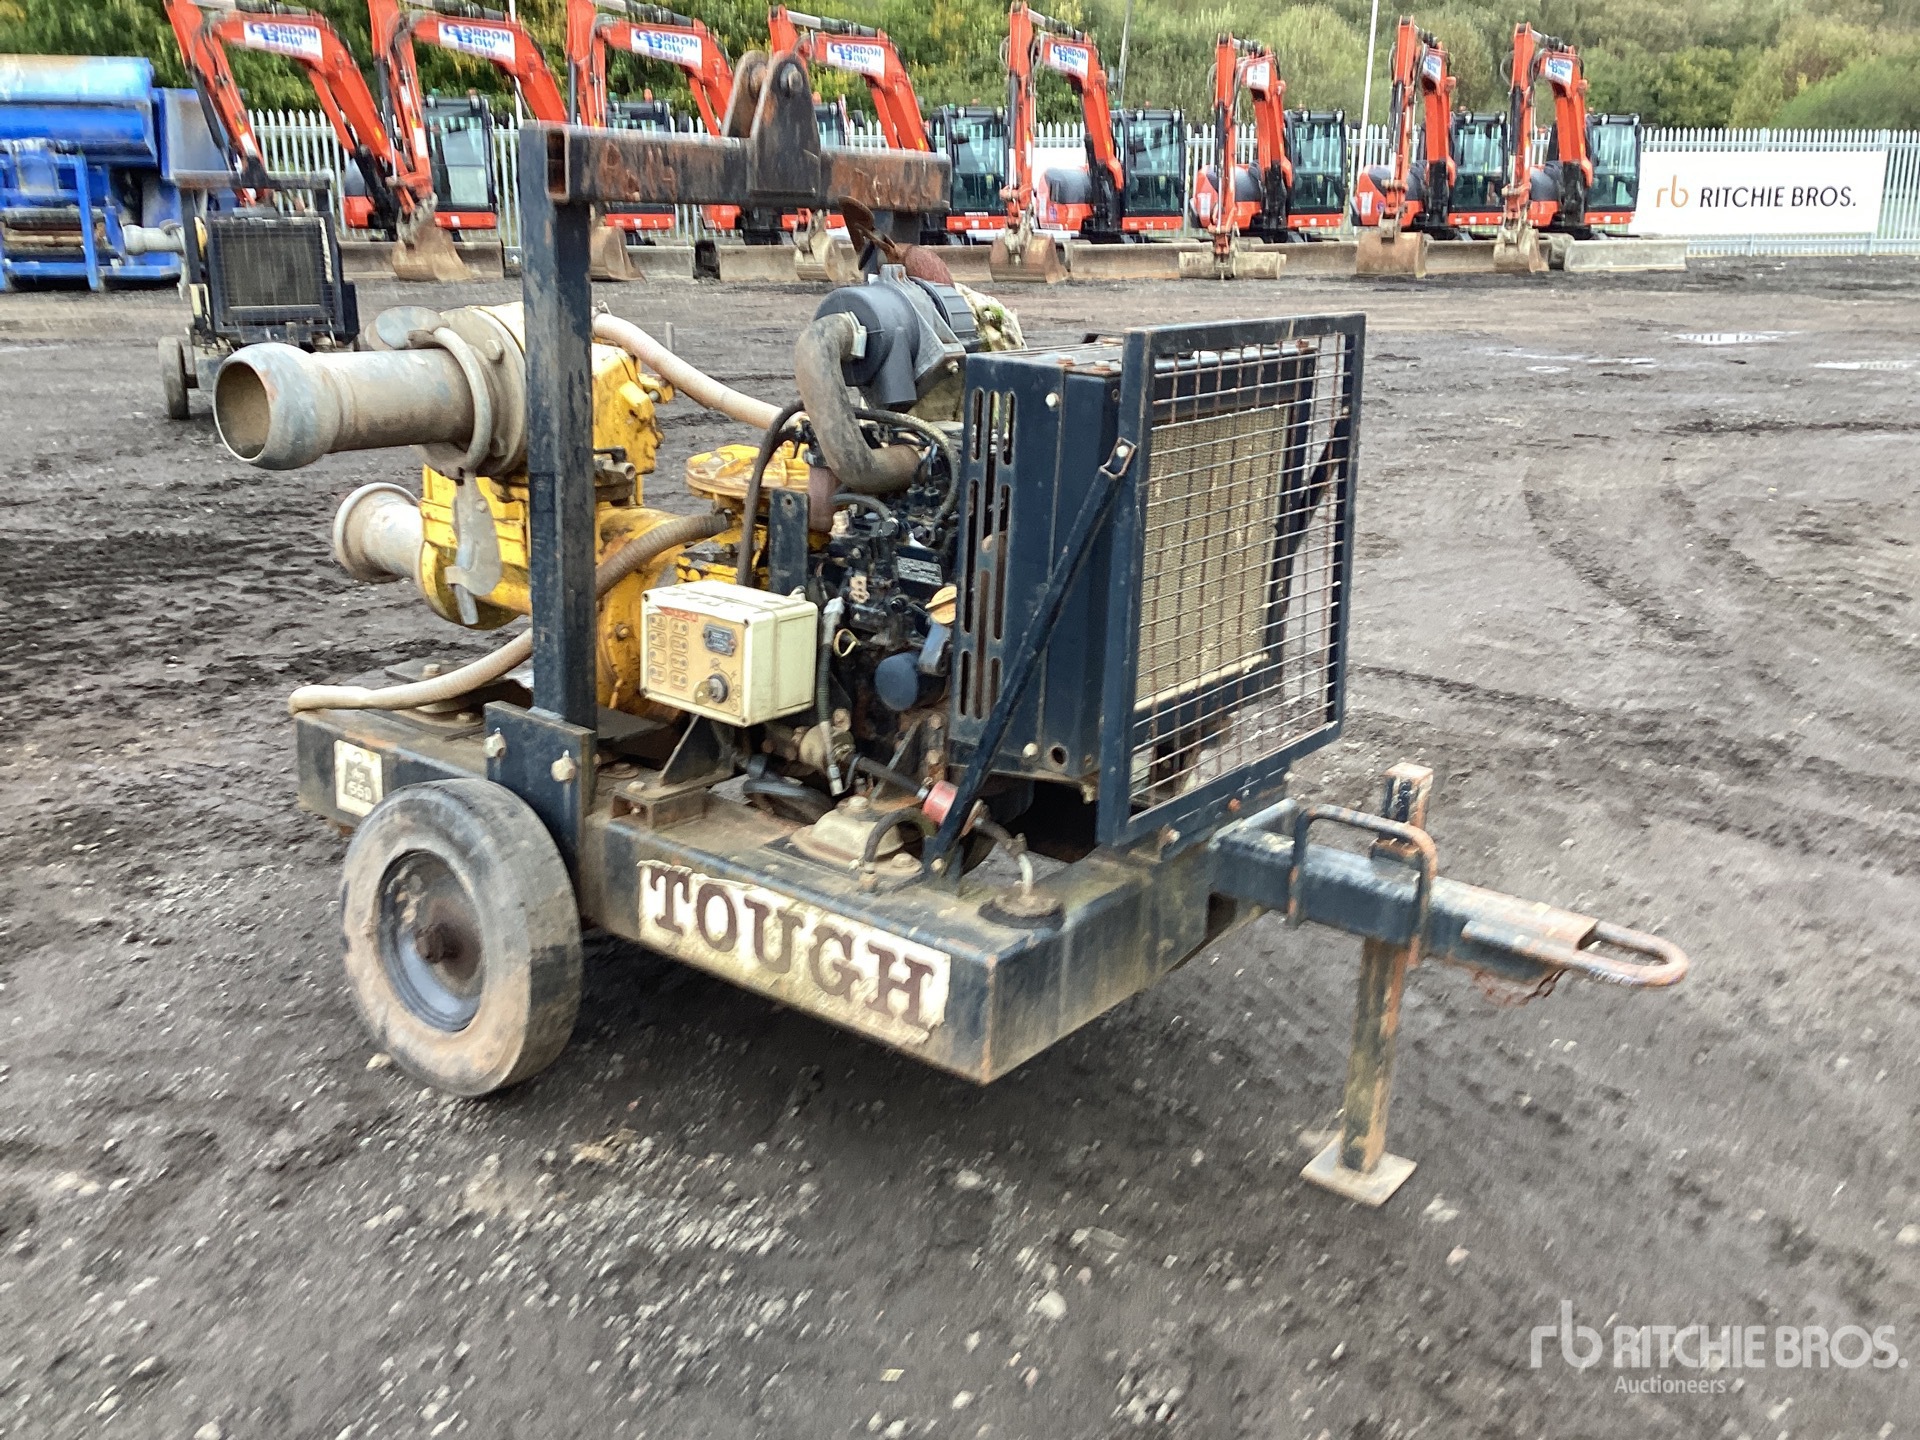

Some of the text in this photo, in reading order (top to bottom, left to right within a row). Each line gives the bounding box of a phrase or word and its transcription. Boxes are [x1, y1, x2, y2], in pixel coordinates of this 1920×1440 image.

[249, 22, 317, 39] GORDON
[443, 23, 510, 43] GORDON
[455, 28, 496, 48] BOW
[636, 29, 698, 48] GORDON
[646, 34, 684, 54] BOW
[830, 43, 881, 57] GORDON
[1700, 186, 1785, 208] RITCHIE
[1791, 186, 1856, 207] BROS.
[650, 867, 934, 1027] TOUGH
